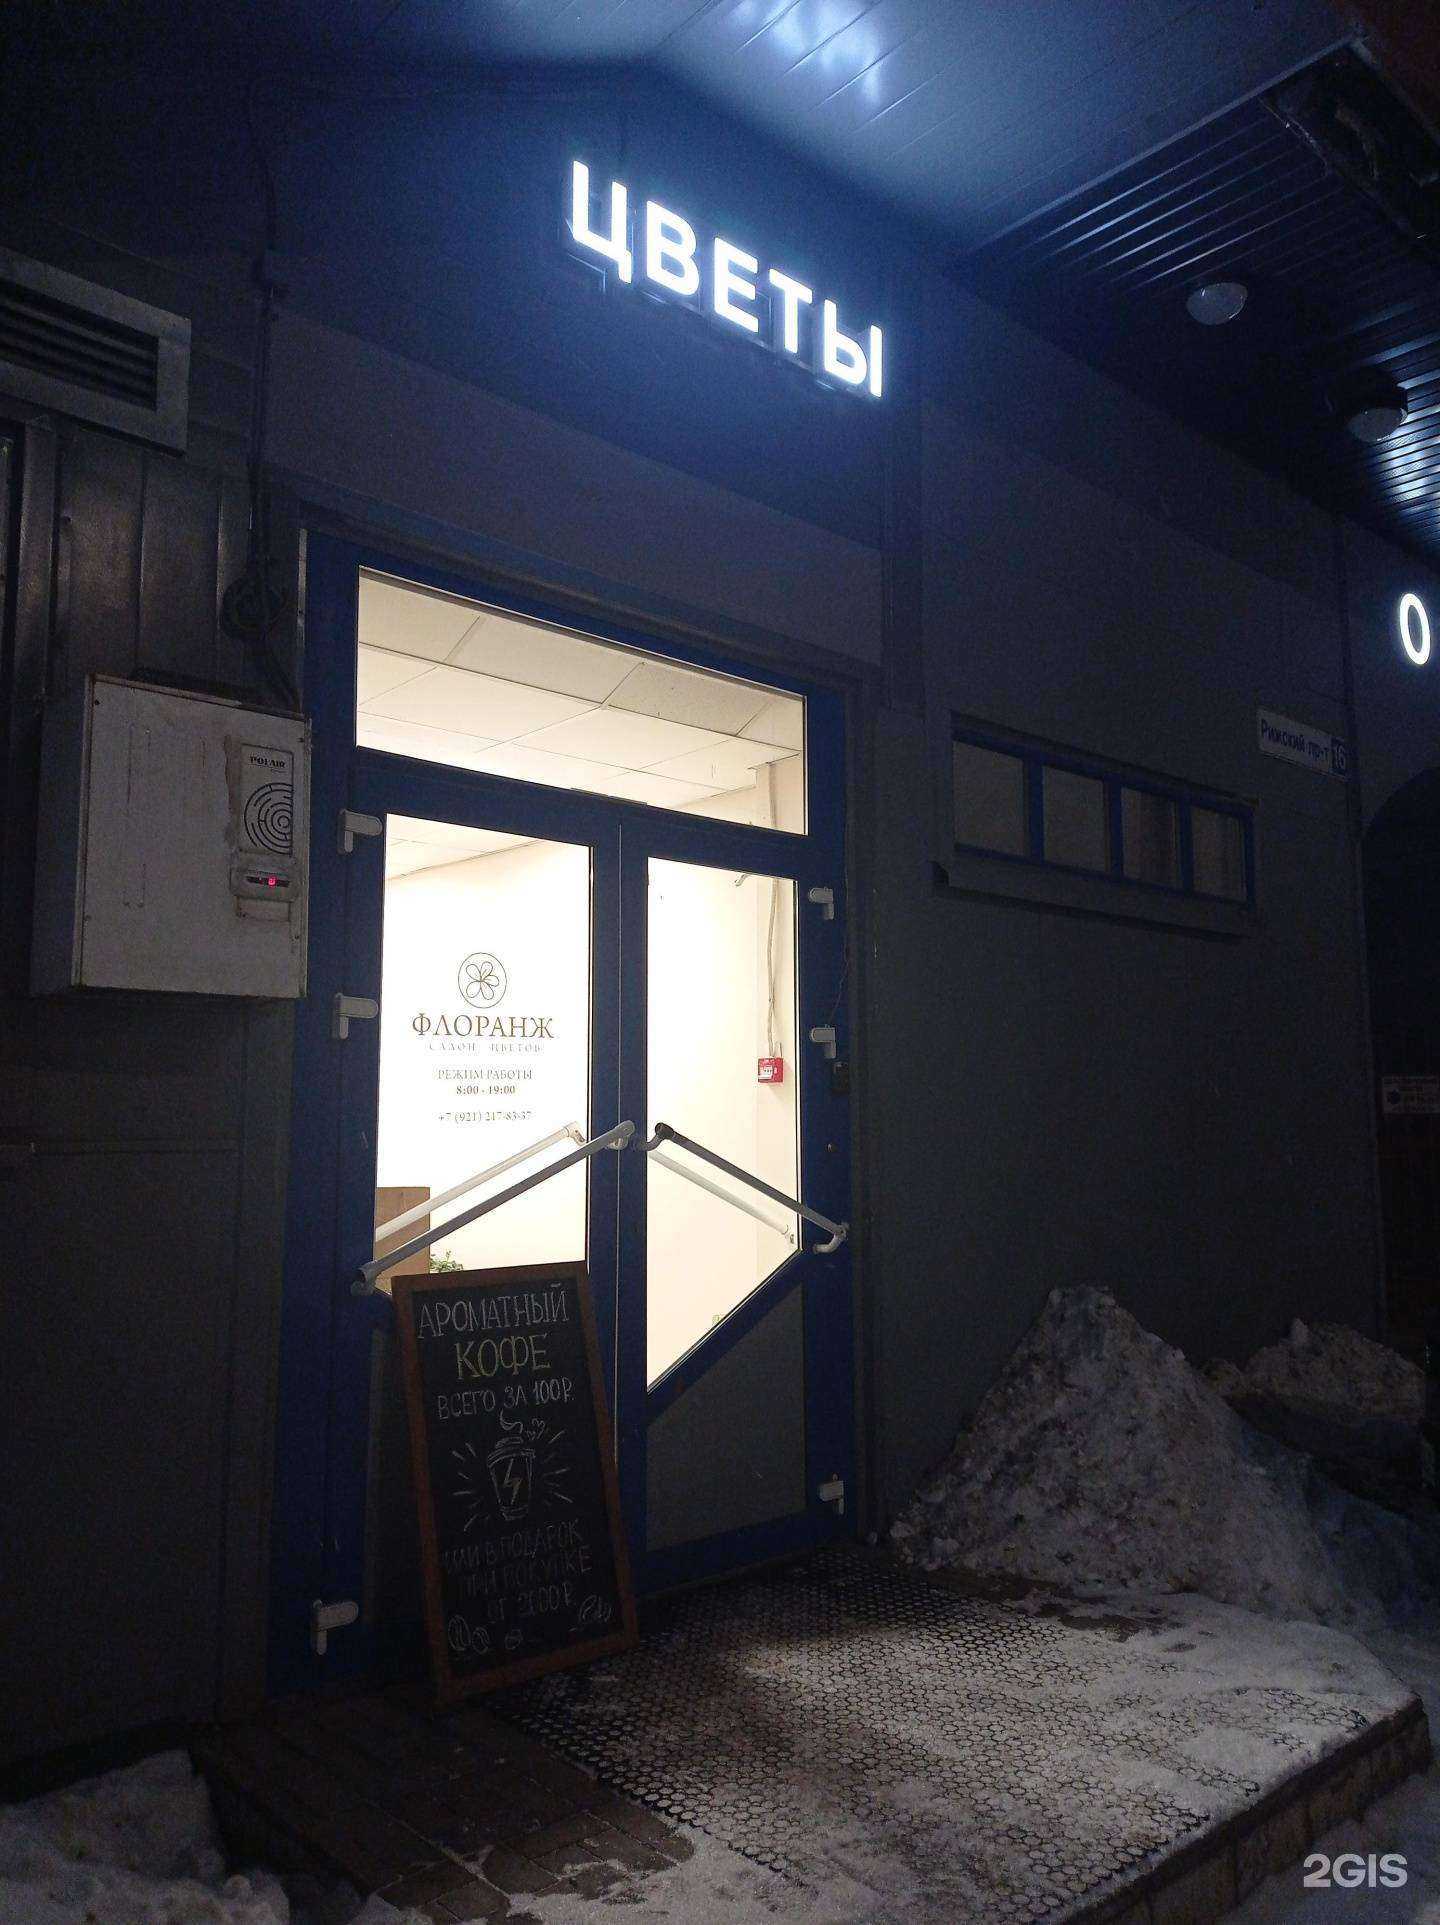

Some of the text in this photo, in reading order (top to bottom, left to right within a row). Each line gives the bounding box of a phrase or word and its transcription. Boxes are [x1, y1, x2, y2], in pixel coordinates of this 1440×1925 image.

[572, 159, 883, 399] ЦВЕТЫ
[412, 1012, 554, 1039] ФЛОРАНЖ
[437, 1068, 533, 1080] РЕЖИМ РАБОТЫ
[456, 1084, 479, 1095] 8:00
[489, 1084, 516, 1095] 19:00
[437, 1112, 452, 1122] +7
[454, 1111, 482, 1125] (921)
[417, 1281, 570, 1339] АРОМАТНЫЙ
[455, 1332, 551, 1379] КОФЕ
[437, 1389, 497, 1421] ВСЕГО
[503, 1385, 526, 1408] ЗА
